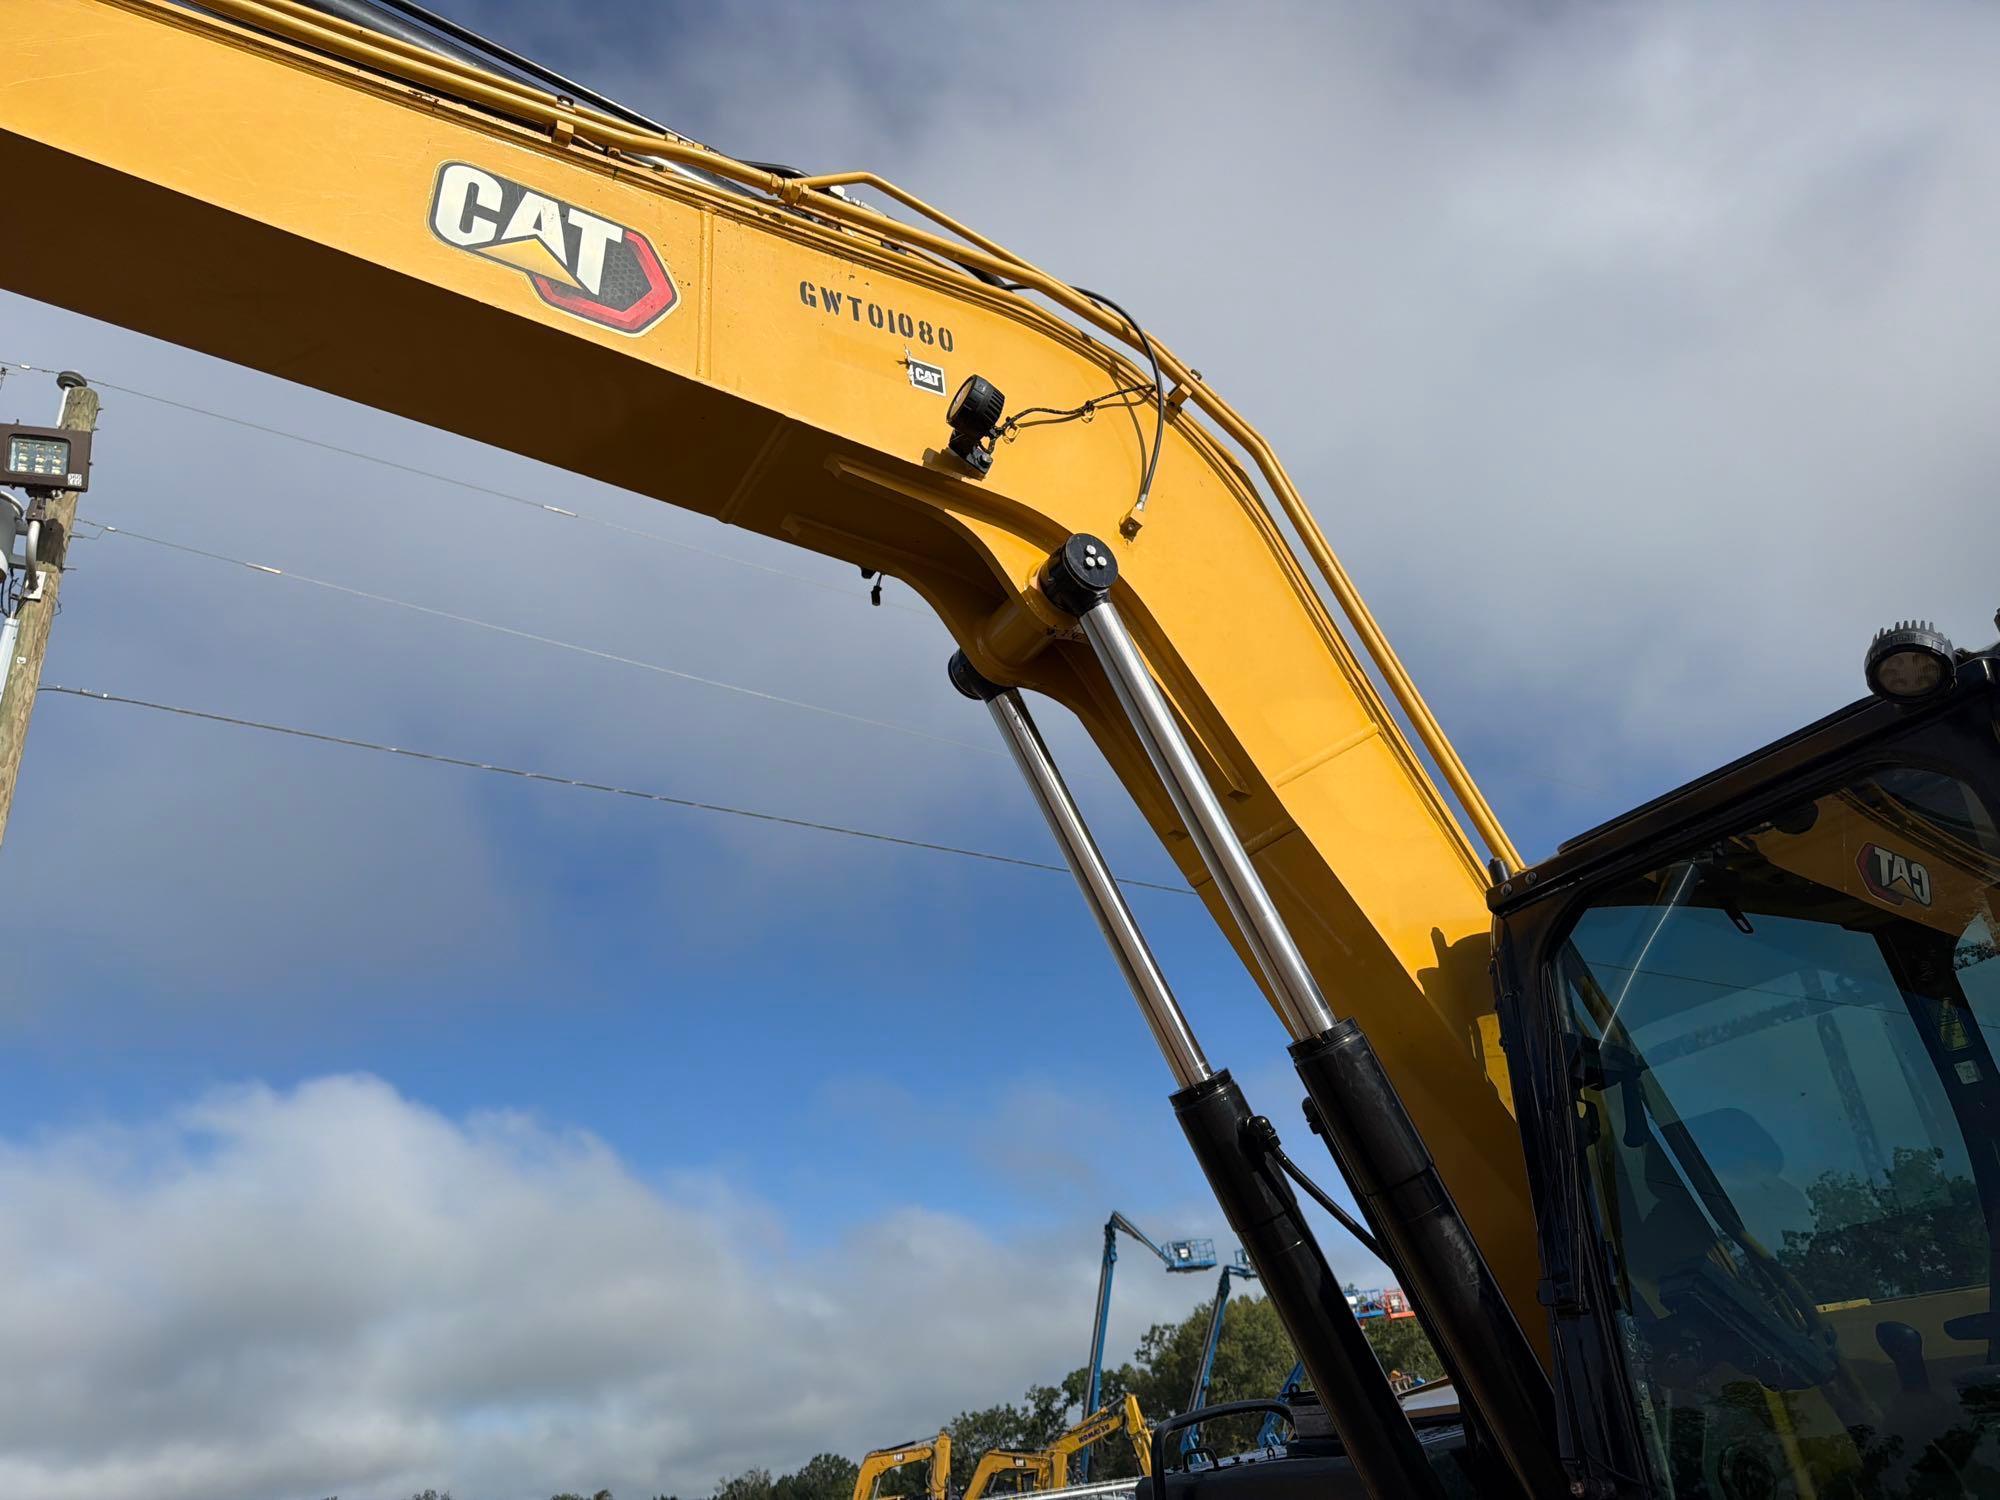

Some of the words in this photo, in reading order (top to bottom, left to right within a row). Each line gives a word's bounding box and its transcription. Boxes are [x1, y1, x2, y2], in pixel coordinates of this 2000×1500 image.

[435, 165, 623, 296] CAT
[799, 281, 954, 353] GWT01080
[915, 367, 941, 387] CAT
